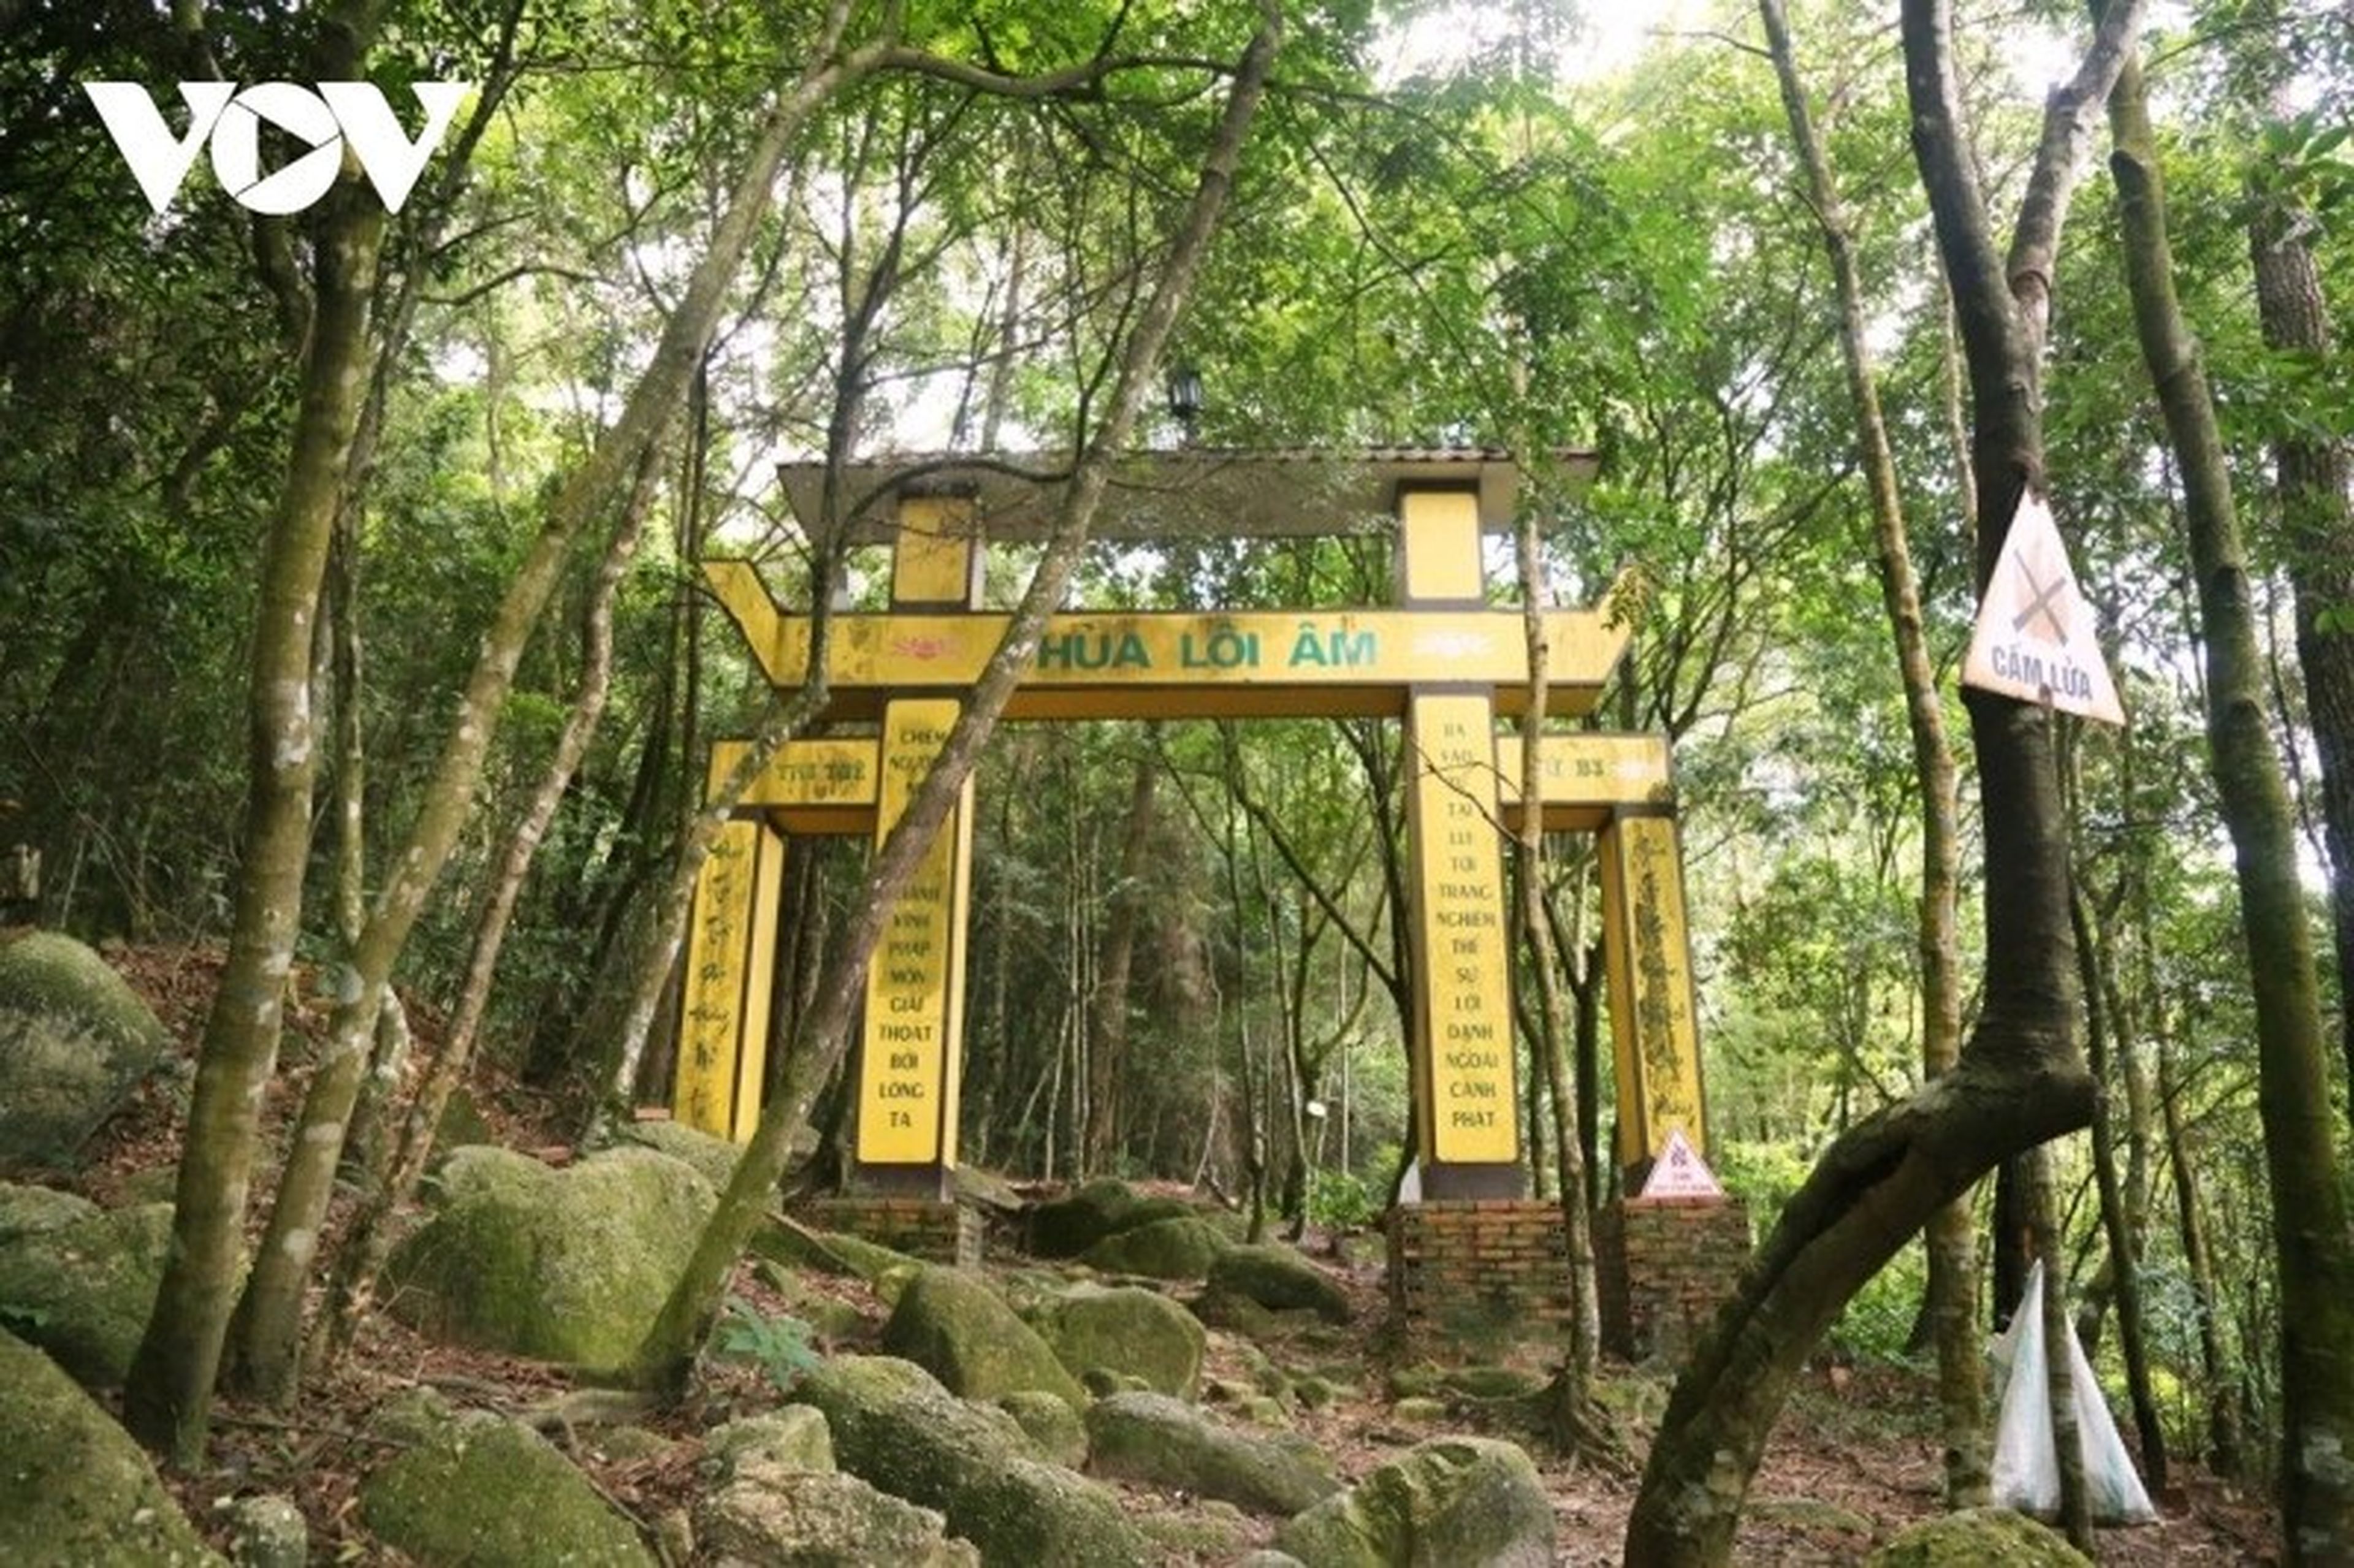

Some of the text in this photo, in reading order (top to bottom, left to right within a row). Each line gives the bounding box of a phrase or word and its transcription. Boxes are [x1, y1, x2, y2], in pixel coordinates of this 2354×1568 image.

[1180, 620, 1259, 668] LÔI
[1288, 621, 1375, 666] ÂM
[888, 1110, 912, 1128] TA
